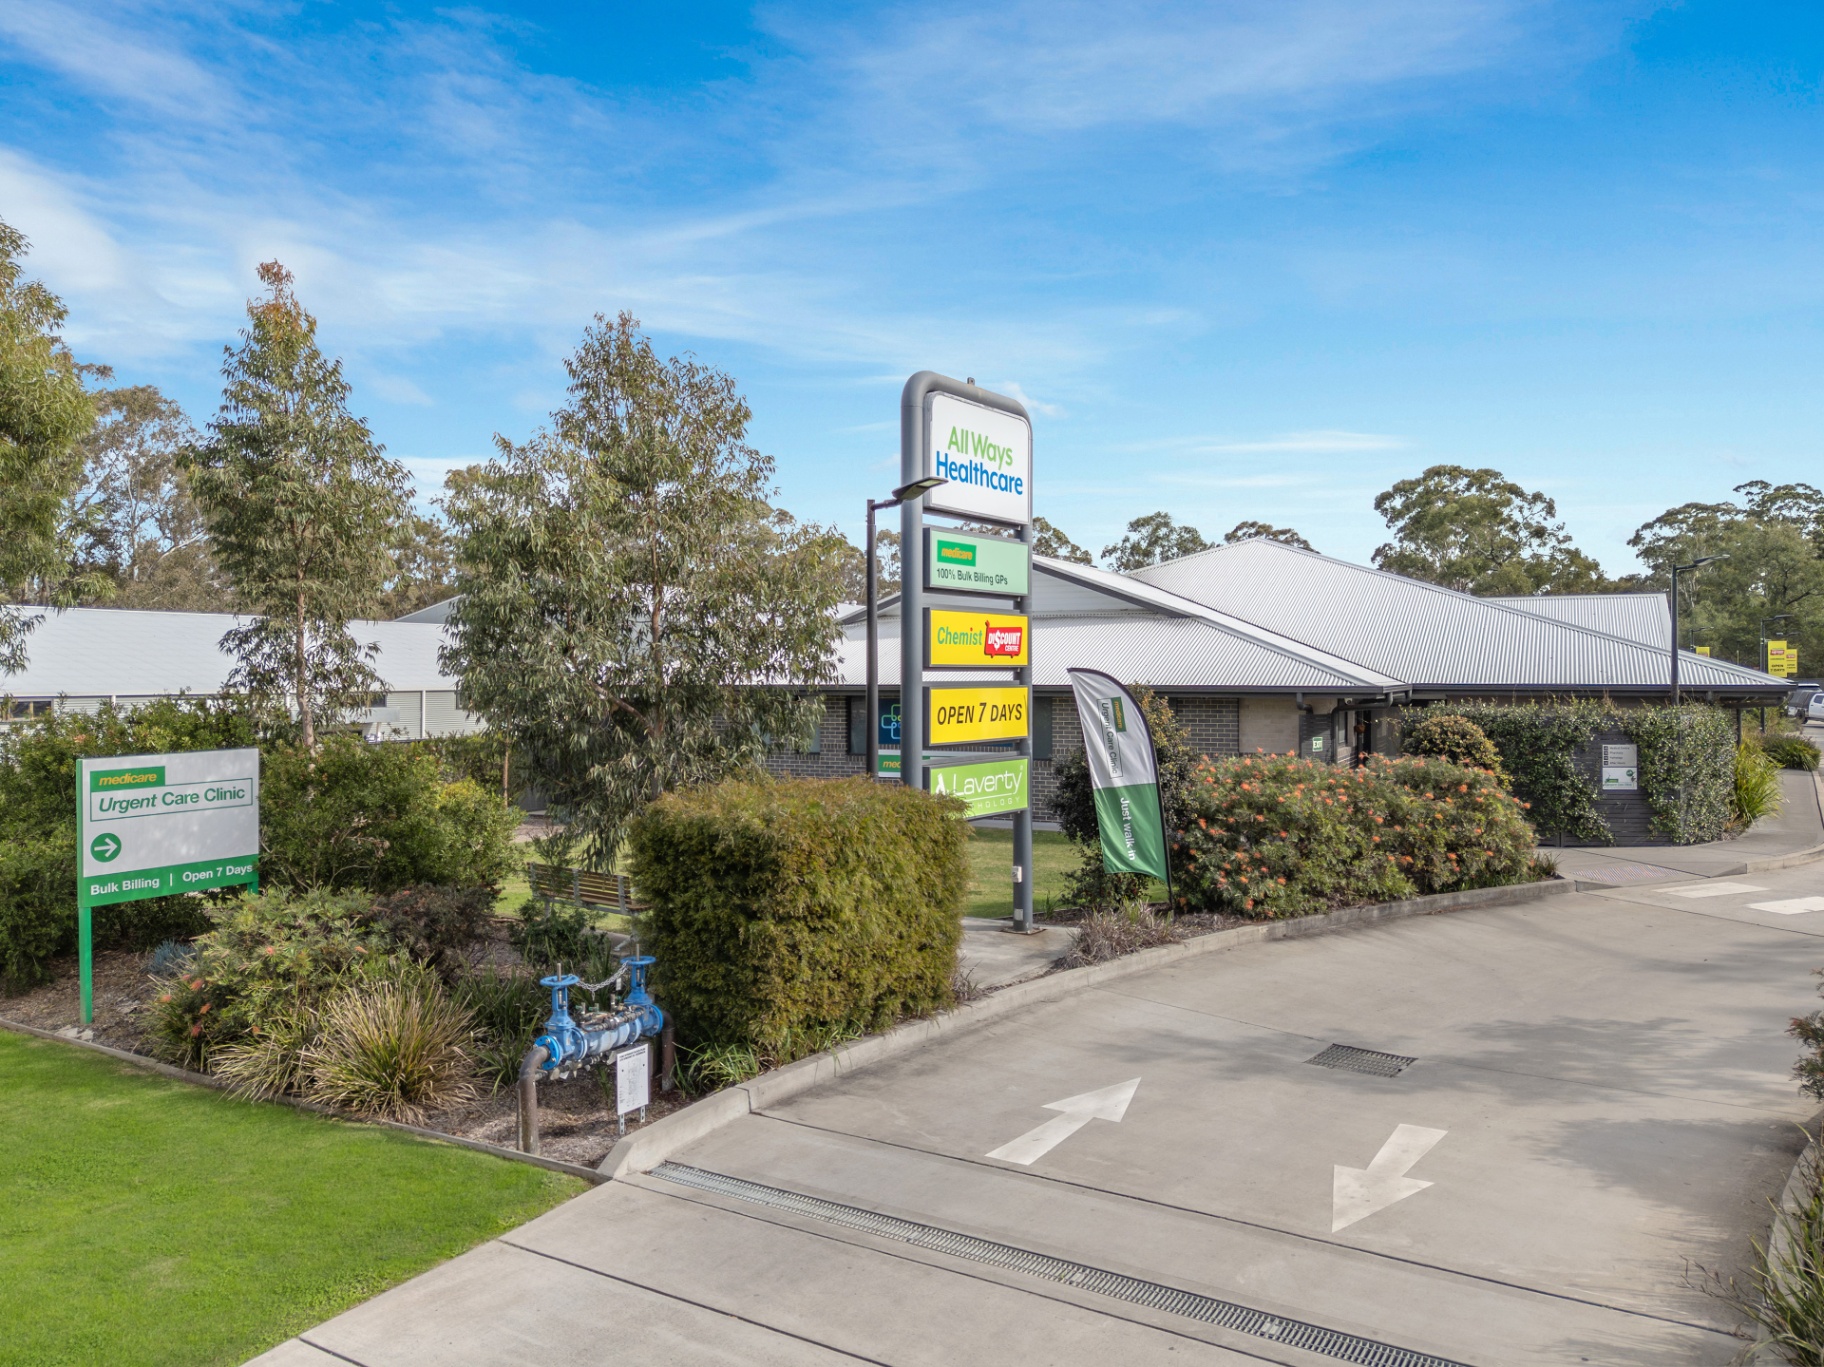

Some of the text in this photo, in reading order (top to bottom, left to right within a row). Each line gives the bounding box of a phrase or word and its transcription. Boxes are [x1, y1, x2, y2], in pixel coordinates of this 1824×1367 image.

[948, 426, 1013, 471] All Ways
[936, 451, 1023, 495] Healthcare
[941, 547, 973, 560] medicare
[936, 568, 1008, 586] 100% Bulk Billing GPs
[937, 626, 982, 645] Chemist
[937, 702, 1023, 725] OPEN 7 DAYS
[1113, 701, 1123, 729] medicare
[1101, 702, 1118, 774] Urgent Care Clinic
[99, 773, 157, 786] medicare
[953, 770, 1023, 796] Laverty
[99, 786, 245, 813] Urgent Care Clinic
[977, 797, 1020, 808] HOLOGY
[1120, 797, 1131, 821] Just
[1127, 849, 1136, 860] in
[91, 864, 253, 895] Bulk Billing Open 7 Days
